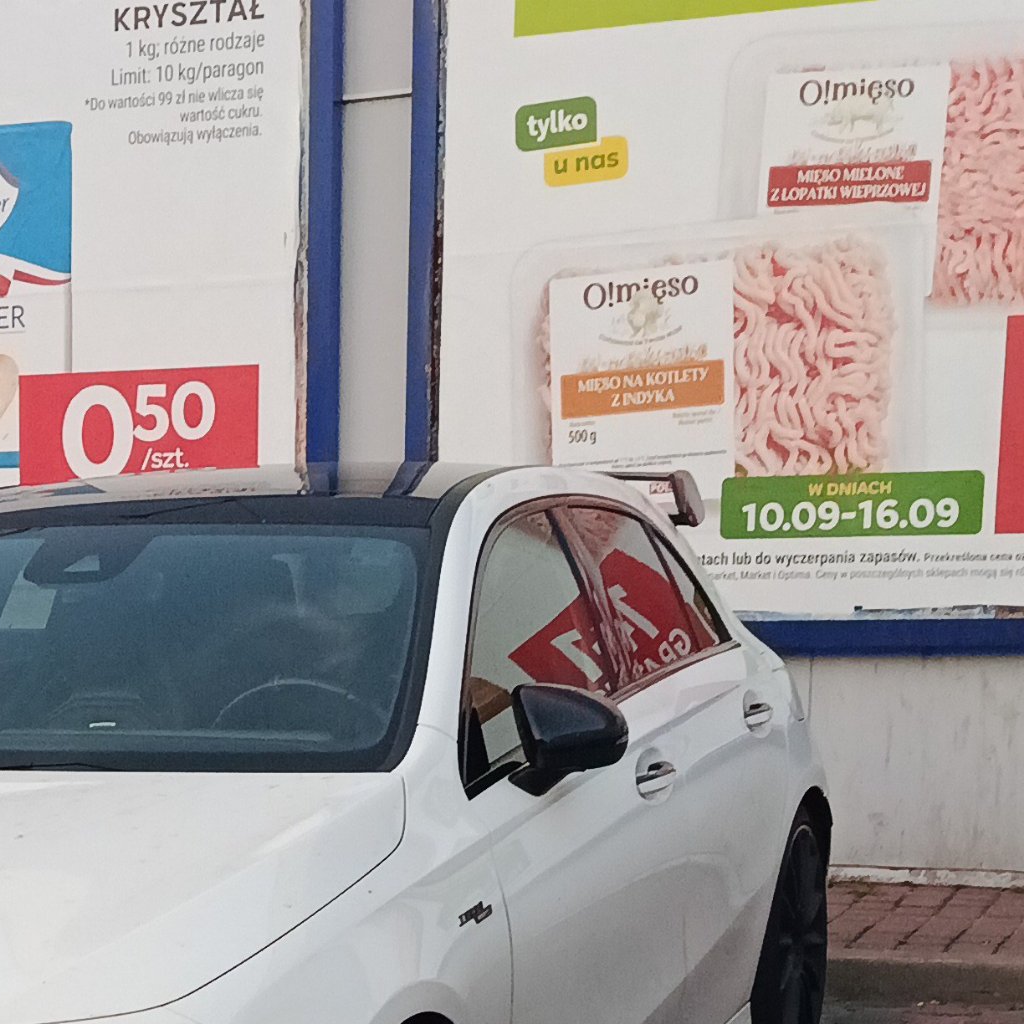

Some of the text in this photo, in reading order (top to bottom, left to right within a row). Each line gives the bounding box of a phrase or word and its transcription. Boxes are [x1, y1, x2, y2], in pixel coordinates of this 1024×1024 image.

[114, 0, 265, 32] KRYSZTAŁ
[126, 41, 132, 58] 1
[163, 35, 206, 55] różne
[210, 31, 266, 53] rodzaje
[111, 60, 264, 86] Limit: 10 kg/paragon
[108, 92, 156, 110] wartości
[158, 91, 173, 106] 99
[175, 92, 186, 105] zł
[188, 89, 205, 104] nie
[208, 87, 245, 103] wlicza
[247, 85, 264, 102] się
[180, 104, 263, 123] wartość cukru.
[526, 108, 588, 142] tylko
[128, 123, 262, 146] Obowiązują wyłączenia.
[553, 151, 619, 175] u nas
[796, 166, 905, 185] MIĘSO MIELONE
[770, 188, 781, 202] Z
[839, 182, 927, 199] WIEPRZOWEJ
[577, 367, 710, 393] MIĘSO NA KOTLETY
[610, 389, 676, 408] Z INDYKA
[568, 429, 597, 445] 500 g
[141, 447, 190, 471] /szt.
[808, 480, 893, 497] W DNIACH
[741, 497, 960, 532] 10.09-16.09
[732, 552, 751, 566] lub
[755, 551, 772, 565] do
[775, 550, 855, 568] wyczerpania
[859, 548, 921, 566] zapasów.
